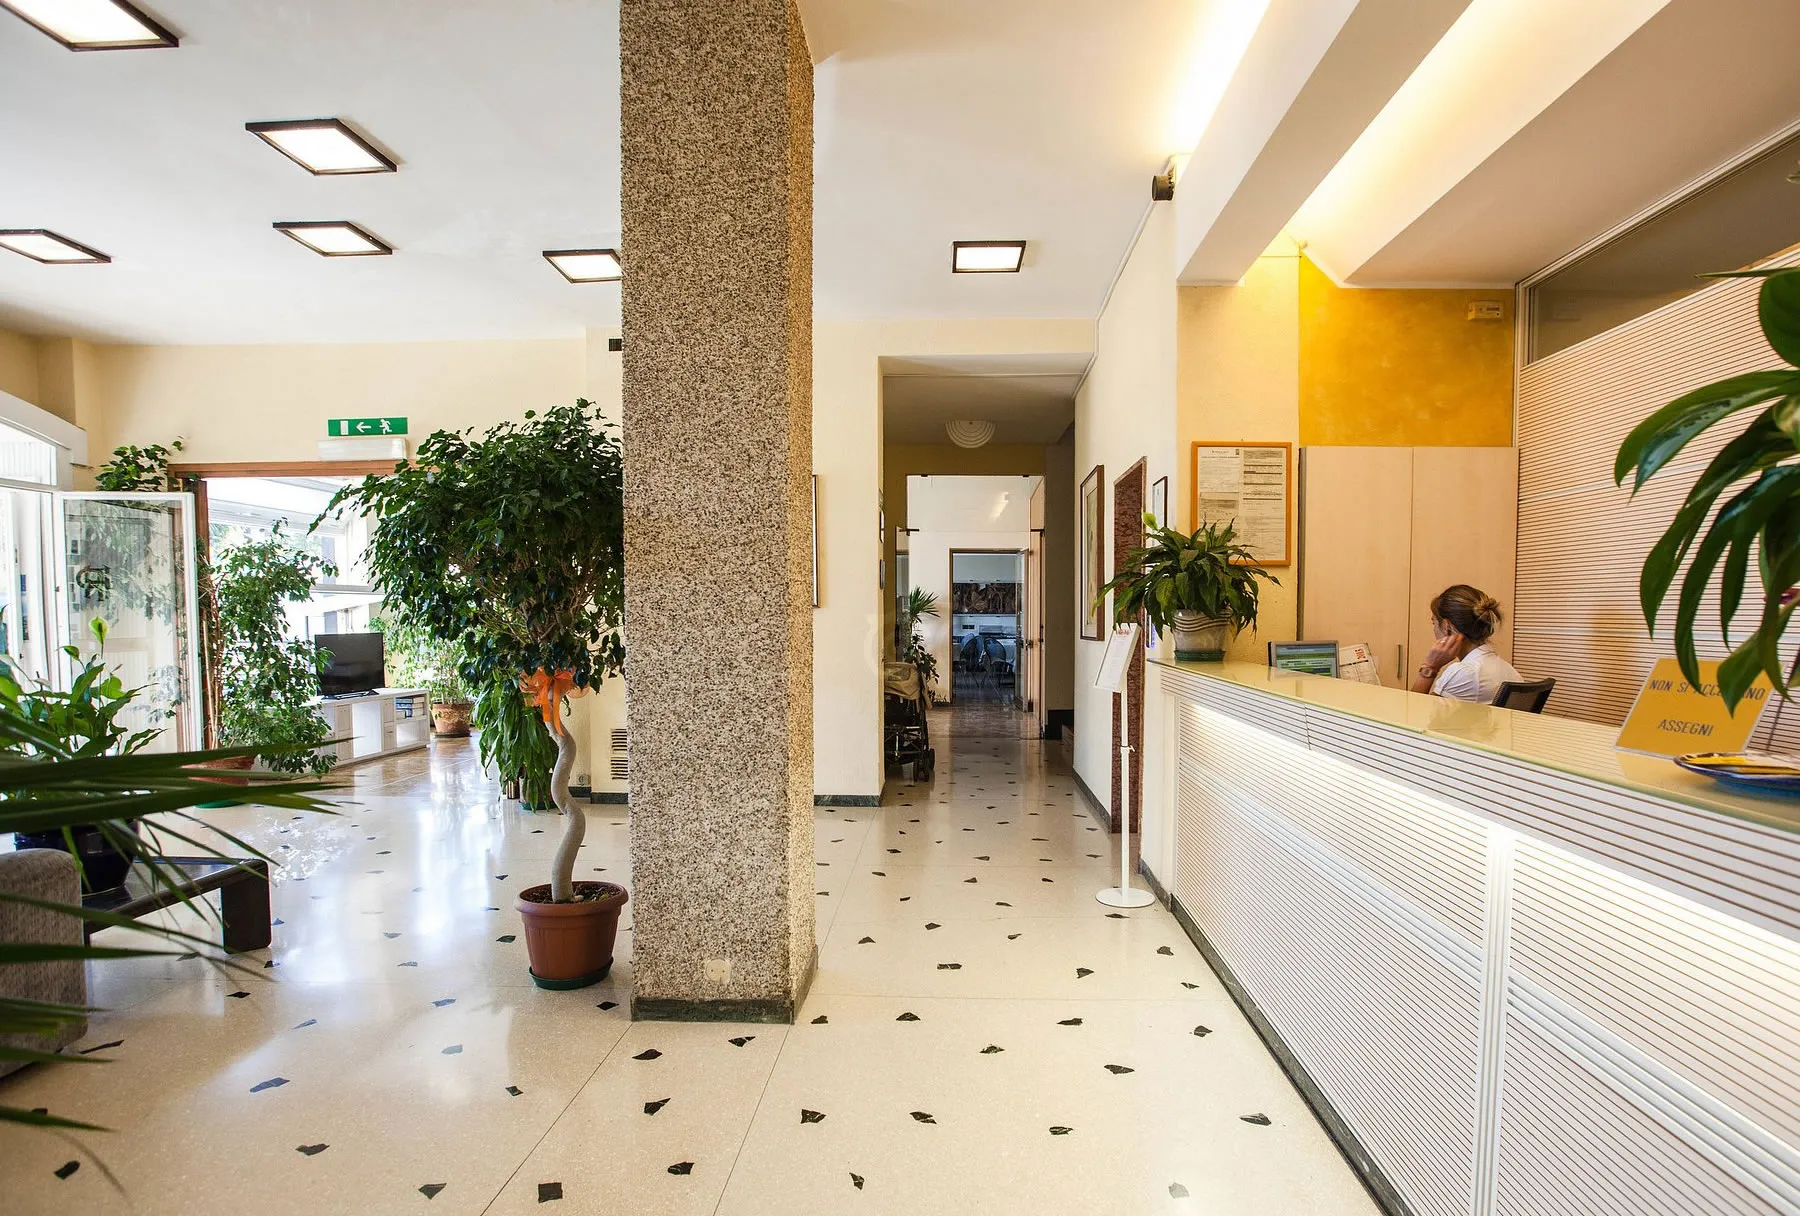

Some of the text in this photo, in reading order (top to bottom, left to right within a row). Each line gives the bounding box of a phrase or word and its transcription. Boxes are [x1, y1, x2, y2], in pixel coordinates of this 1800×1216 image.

[1649, 679, 1673, 691] NON
[1677, 681, 1690, 693] SI
[1657, 719, 1714, 737] ASSEGNI
